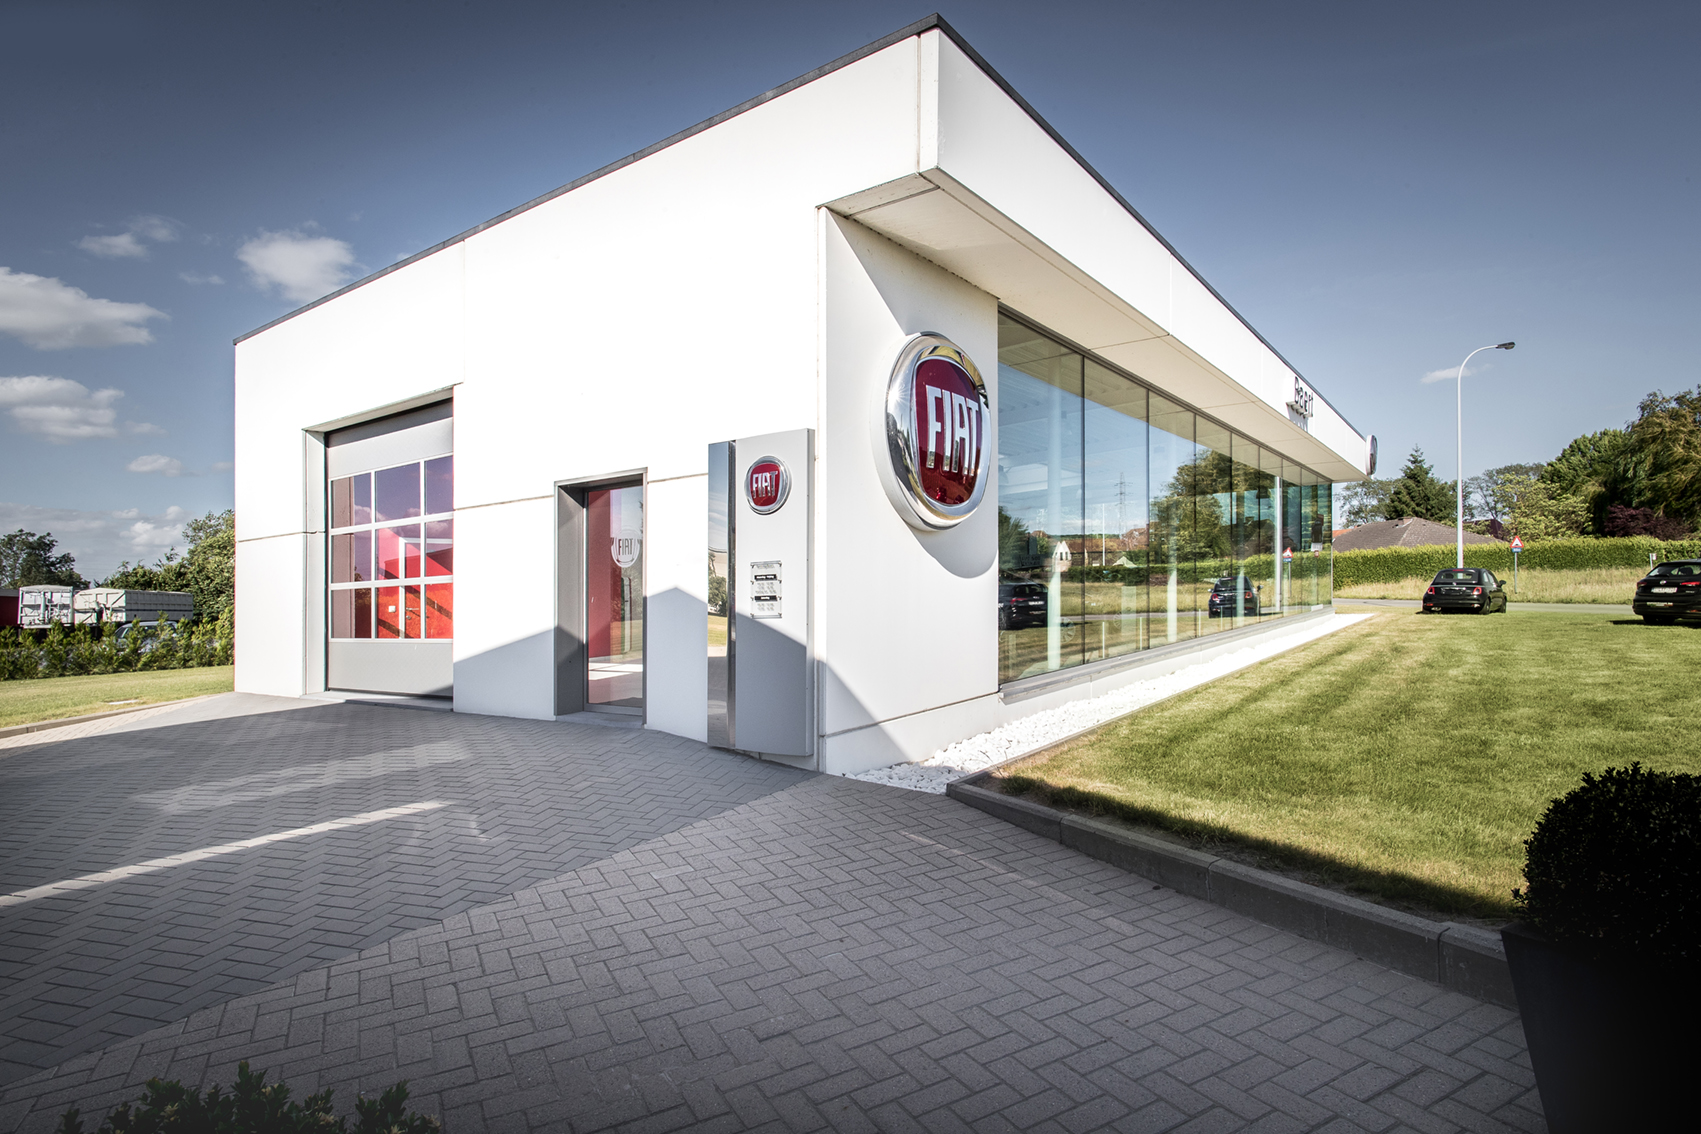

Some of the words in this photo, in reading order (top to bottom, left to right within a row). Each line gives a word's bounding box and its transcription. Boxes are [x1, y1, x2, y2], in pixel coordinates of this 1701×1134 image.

[925, 384, 979, 477] FIAT
[752, 470, 778, 499] FIAT
[618, 538, 633, 556] FIAT
